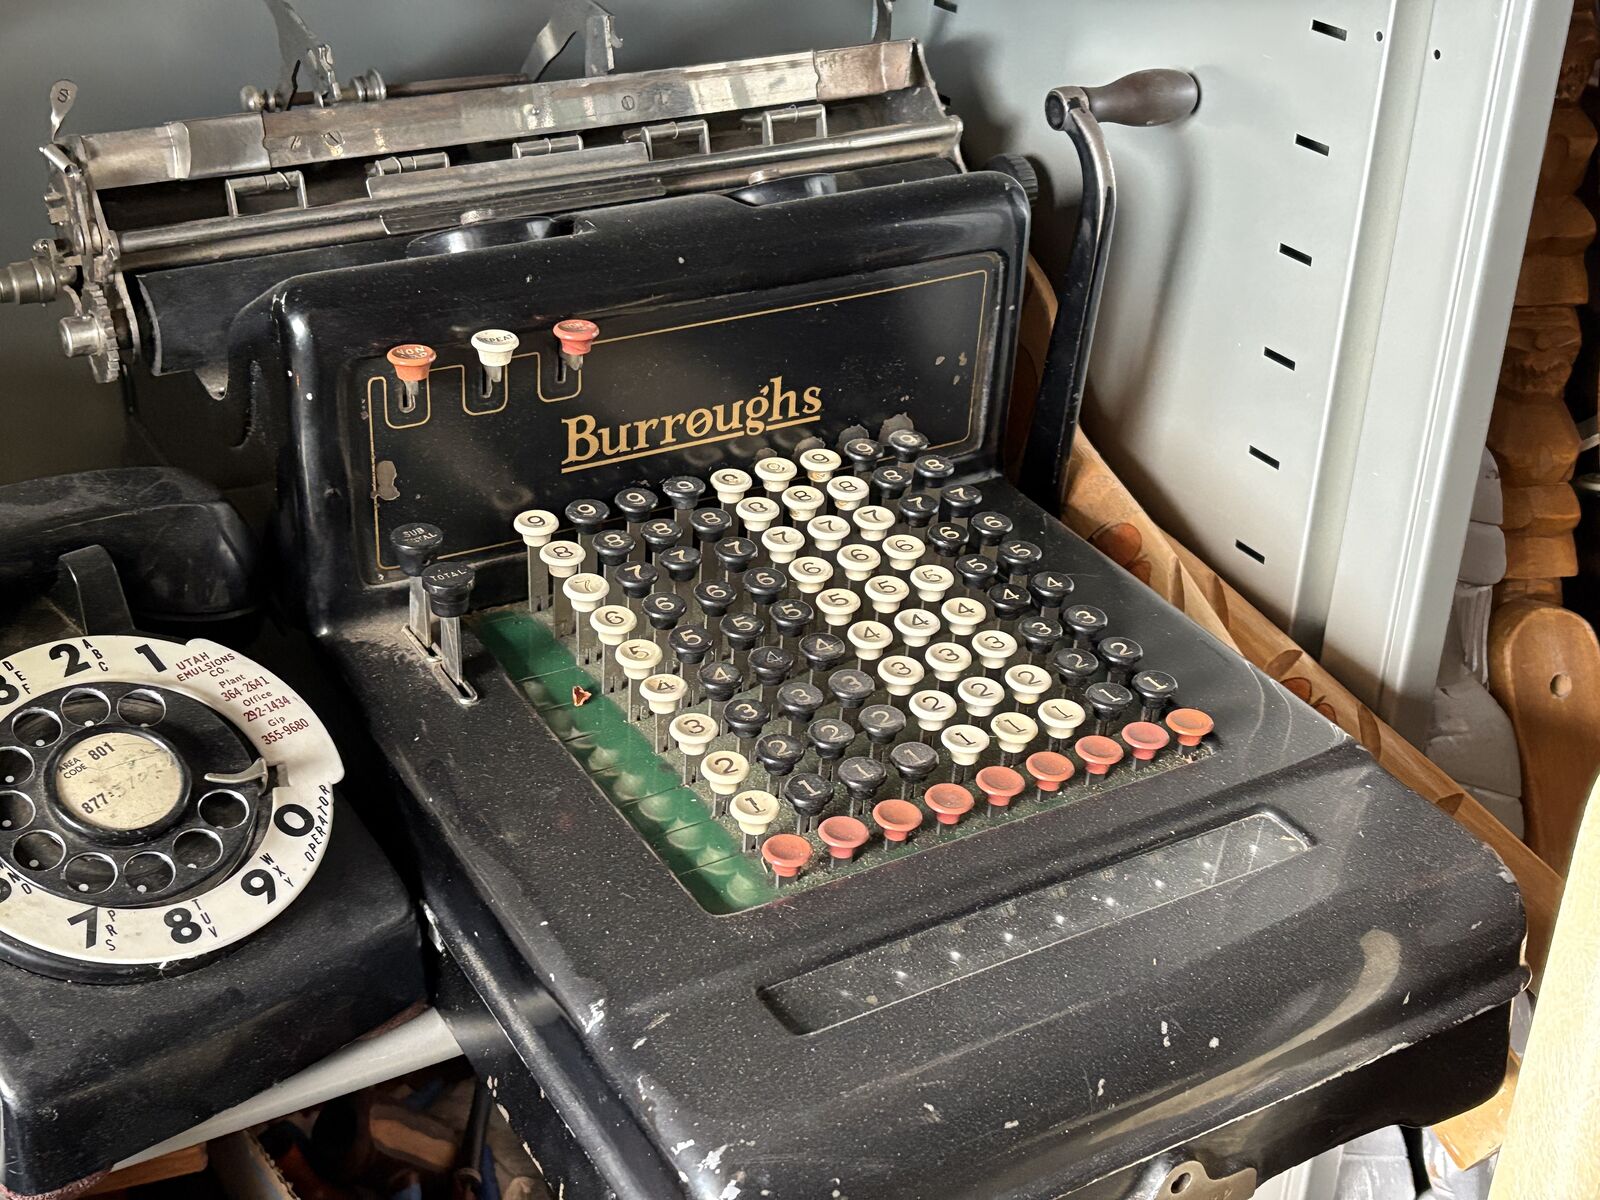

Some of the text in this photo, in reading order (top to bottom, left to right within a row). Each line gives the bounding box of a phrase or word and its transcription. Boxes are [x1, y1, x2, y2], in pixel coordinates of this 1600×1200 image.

[57, 88, 69, 103] S
[561, 375, 822, 465] Burroughs
[856, 443, 874, 454] 9
[812, 453, 829, 463] 9
[925, 459, 945, 469] 8
[883, 470, 902, 481] 8
[677, 481, 695, 491] 9
[839, 481, 858, 491] 8
[626, 493, 646, 505] 9
[794, 490, 812, 500] 8
[950, 488, 967, 499] 7
[577, 504, 596, 516] 9
[907, 497, 925, 510] 7
[528, 516, 545, 526] 9
[701, 512, 721, 524] 8
[863, 510, 881, 521] 7
[652, 523, 672, 535] 8
[819, 520, 835, 531] 7
[984, 517, 1003, 528] 6
[402, 527, 425, 538] SUB
[773, 531, 789, 543] 7
[940, 527, 959, 539] 6
[604, 534, 625, 547] 8
[895, 540, 913, 551] 6
[553, 546, 573, 557] 8
[724, 541, 742, 554] 7
[1010, 544, 1031, 557] 5
[670, 550, 686, 561] 7
[851, 549, 869, 560] 6
[625, 564, 642, 579] 7
[802, 562, 821, 574] 6
[966, 559, 988, 572] 5
[430, 569, 467, 582] TOTAL
[756, 572, 775, 585] 6
[922, 569, 942, 582] 5
[878, 581, 896, 593] 5
[1047, 577, 1063, 588] 4
[706, 585, 726, 598] 6
[1003, 589, 1019, 600] 4
[655, 598, 674, 610] 6
[828, 593, 848, 606] 5
[781, 603, 801, 618] 5
[958, 602, 975, 613] 4
[605, 611, 624, 624] 6
[732, 617, 753, 630] 5
[912, 614, 929, 625] 4
[1076, 610, 1096, 624] 3
[863, 627, 880, 638] 4
[1032, 622, 1052, 635] 3
[680, 629, 702, 645] 5
[985, 636, 1005, 648] 3
[629, 646, 649, 658] 5
[938, 649, 959, 661] 3
[1111, 642, 1133, 656] 2
[49, 643, 92, 678] 2
[134, 643, 168, 673] 1
[175, 651, 210, 671] UTAH
[767, 651, 782, 662] 4
[1067, 654, 1088, 669] 2
[176, 653, 235, 682] EMULSIONS
[712, 667, 731, 681] 4
[891, 662, 911, 675] 3
[218, 674, 246, 689] Plant
[1018, 671, 1042, 685] 2
[1144, 676, 1167, 691] 1
[220, 676, 270, 702] 364-2641
[657, 680, 675, 691] 4
[971, 683, 994, 697] 2
[242, 691, 273, 707] Office
[1099, 689, 1121, 702] 1
[243, 695, 291, 722] 292-1434
[735, 703, 758, 718] 3
[923, 697, 946, 711] 2
[871, 711, 896, 727] 2
[1052, 706, 1073, 719] 1
[261, 718, 310, 745] 355-9680
[684, 719, 704, 733] 3
[1004, 719, 1026, 732] 1
[821, 725, 848, 740] 2
[955, 732, 976, 745] 1
[87, 741, 116, 761] 801
[768, 740, 792, 756] 2
[904, 749, 924, 763] 1
[59, 757, 81, 772] AREA
[63, 763, 88, 779] CODE
[715, 758, 738, 774] 2
[852, 764, 873, 778] 1
[798, 780, 821, 796] 1
[745, 798, 766, 813] 1
[304, 784, 331, 862] OPERATOR
[240, 868, 277, 905] 9
[67, 906, 98, 949] 7
[163, 907, 202, 944] 8
